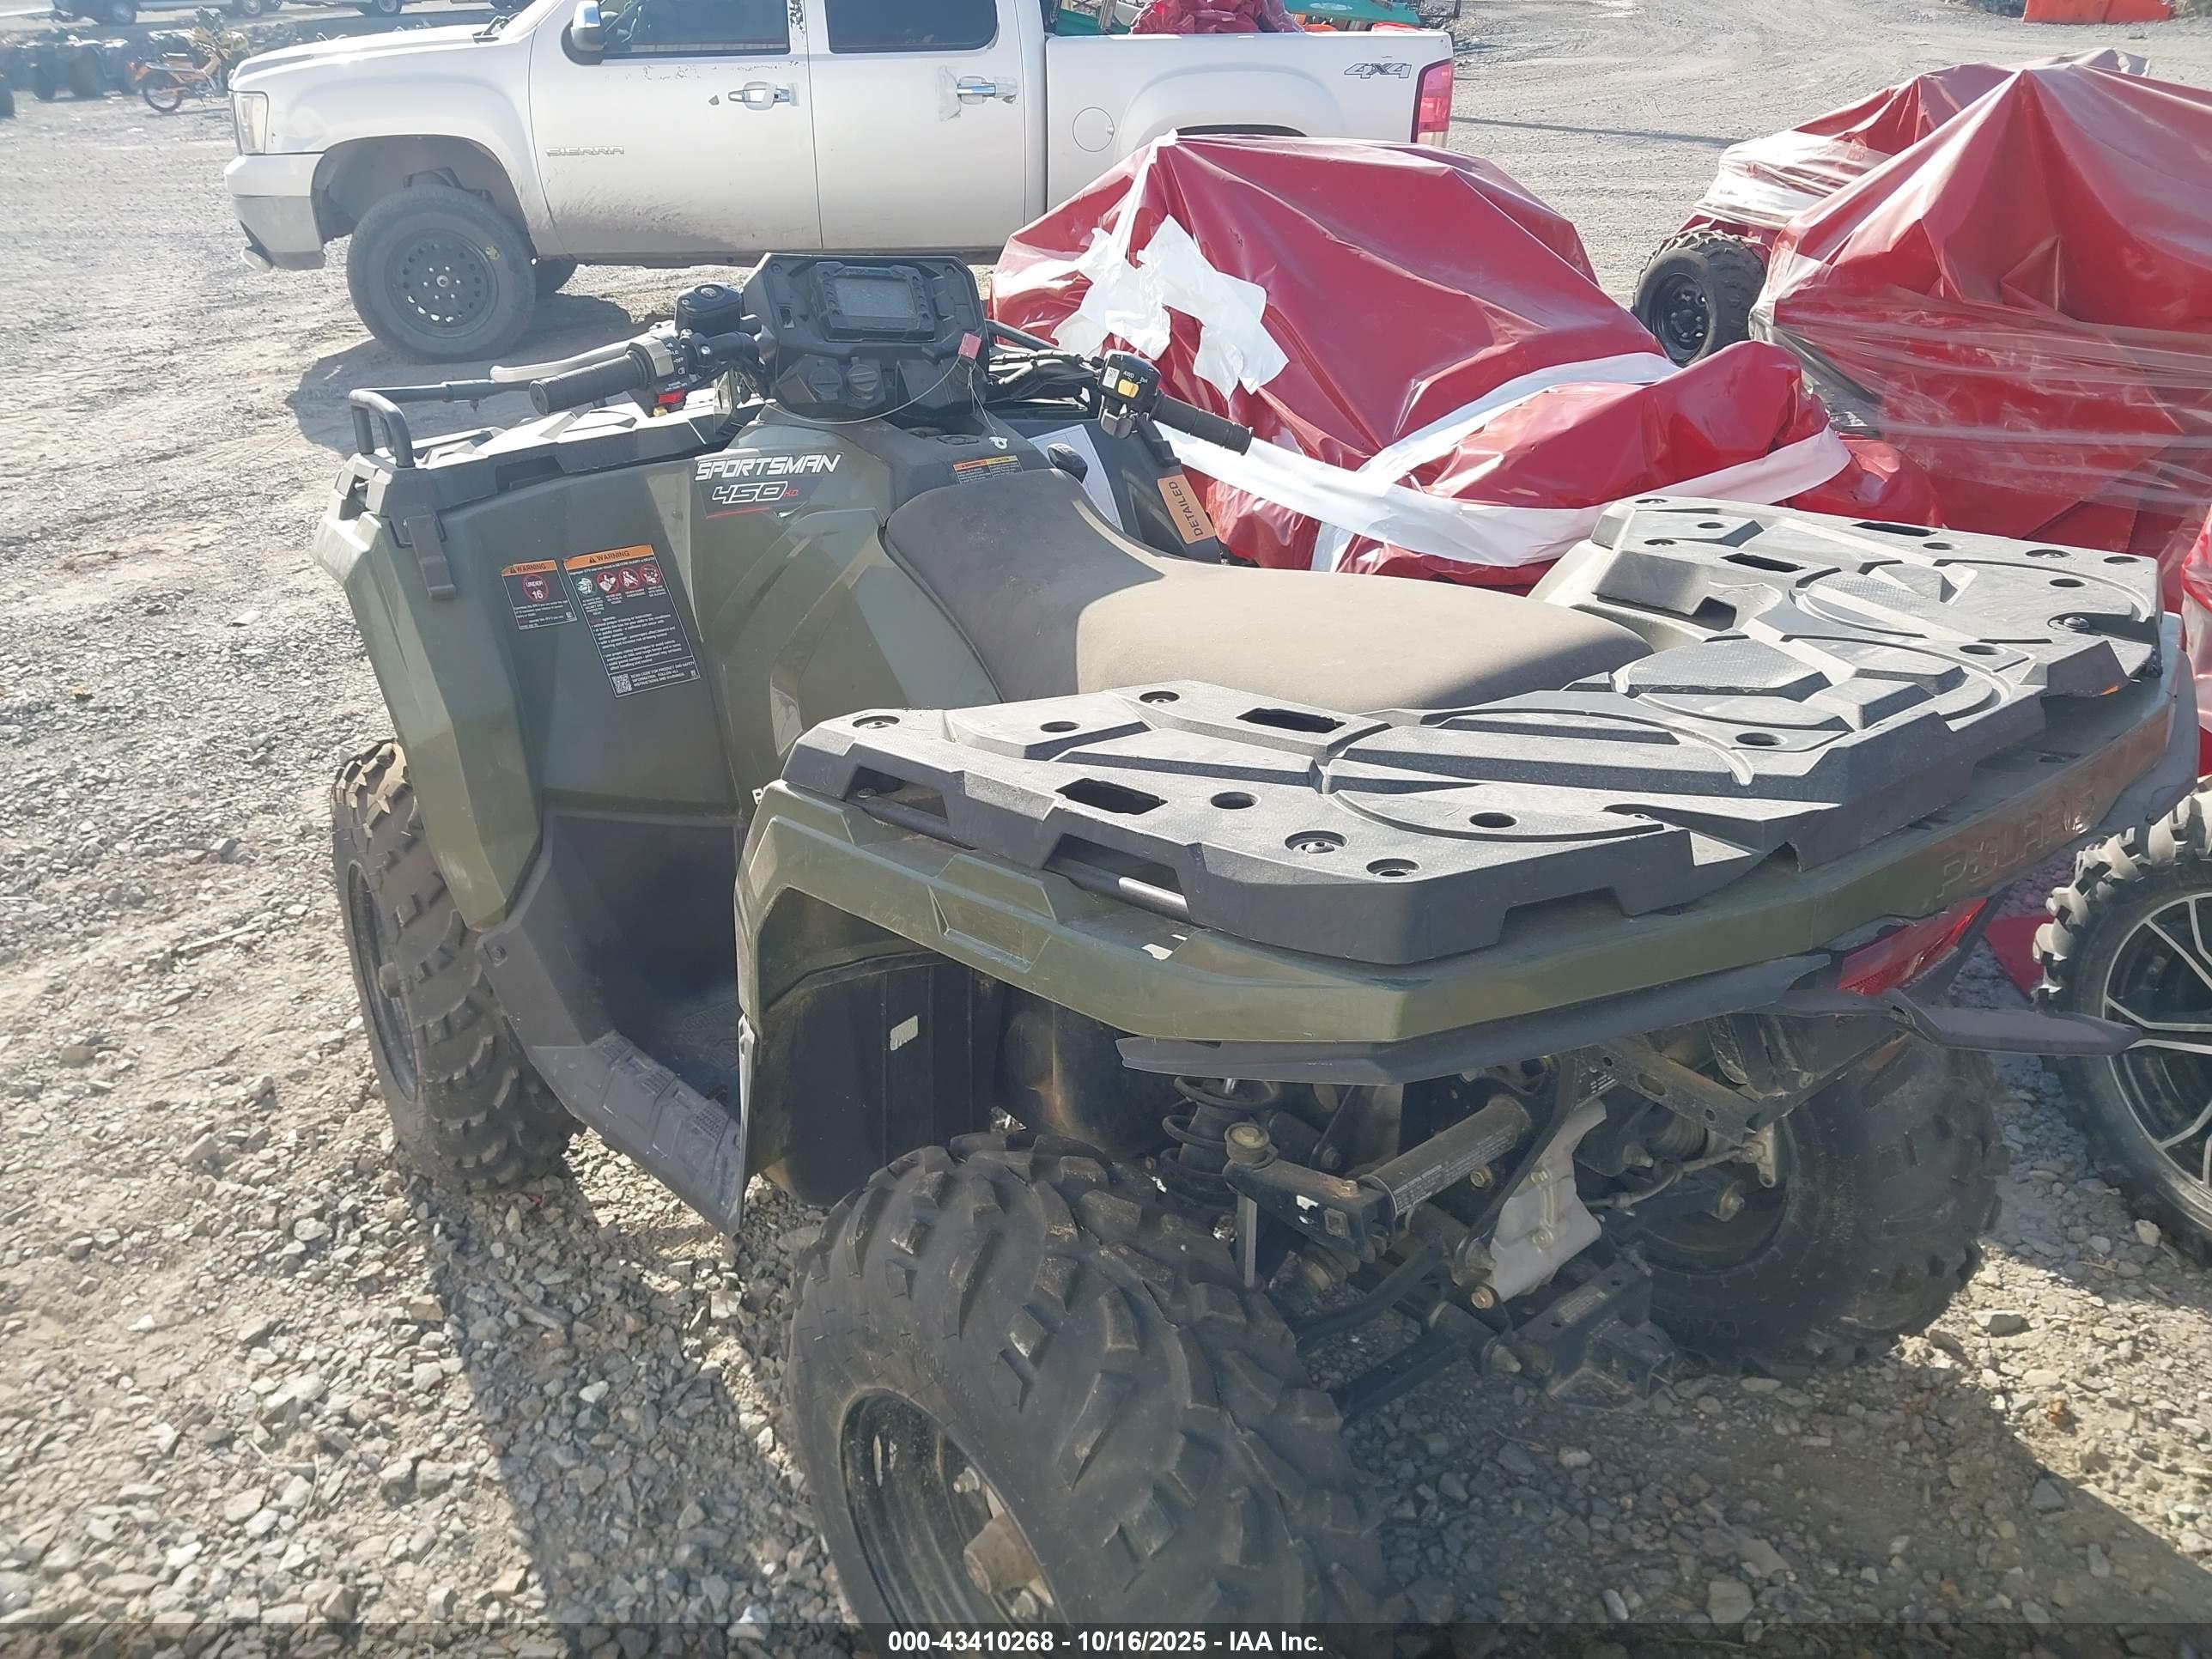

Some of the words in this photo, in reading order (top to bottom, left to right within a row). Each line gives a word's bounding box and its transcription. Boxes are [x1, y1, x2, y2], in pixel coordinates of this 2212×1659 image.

[546, 146, 625, 156] SIERRA
[694, 453, 842, 482] SPORTSMAN
[712, 480, 788, 505] 450
[1169, 481, 1203, 537] DETAILED
[596, 550, 631, 562] WARNING
[517, 562, 547, 573] WARNING
[526, 580, 544, 588] UNDER
[532, 589, 544, 600] 16
